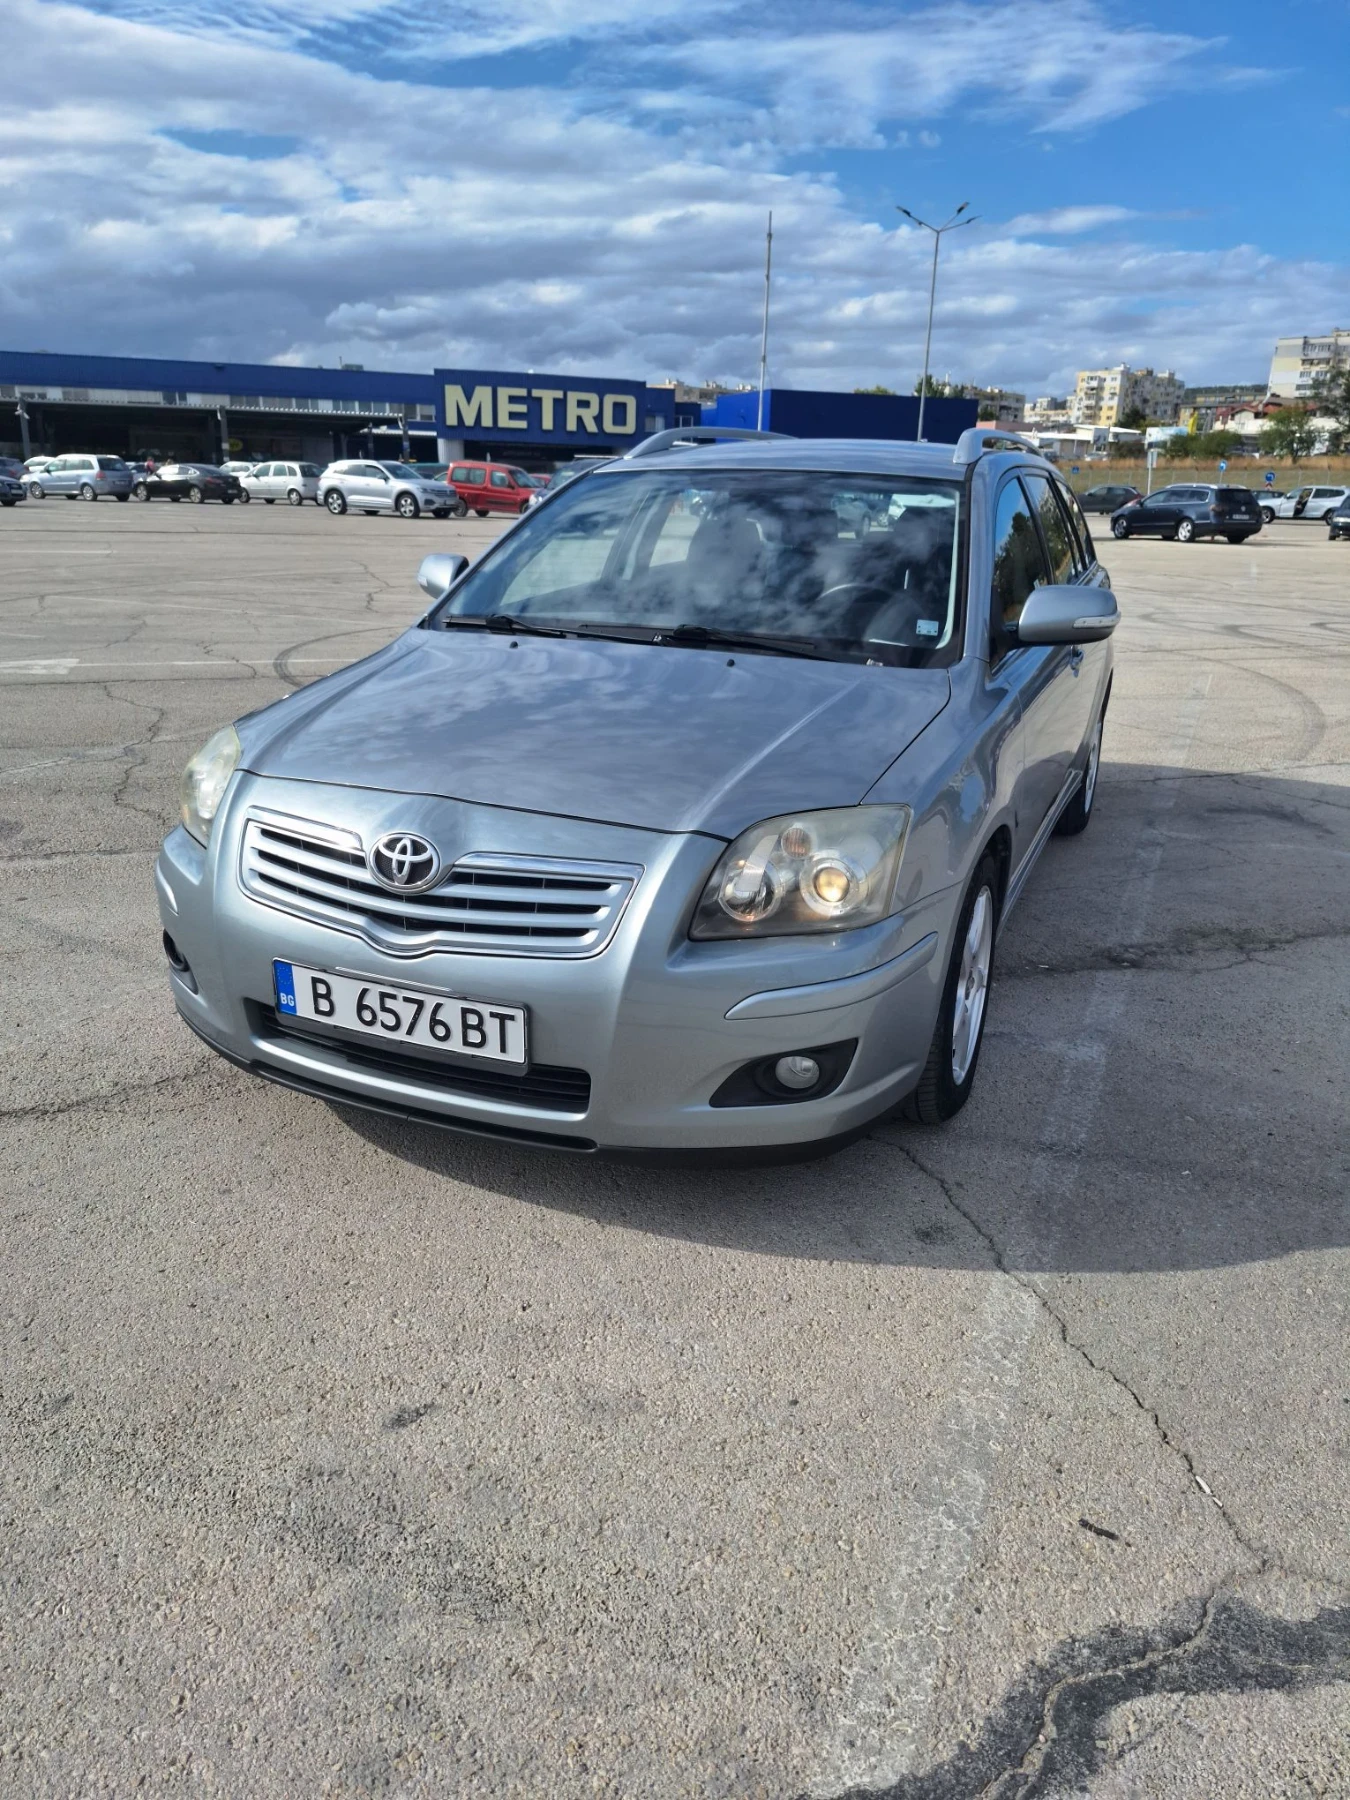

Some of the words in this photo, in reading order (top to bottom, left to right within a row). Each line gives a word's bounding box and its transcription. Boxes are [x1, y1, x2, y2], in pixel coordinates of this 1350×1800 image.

[445, 385, 636, 434] METRO
[280, 992, 295, 1007] BG
[311, 976, 335, 1017] B
